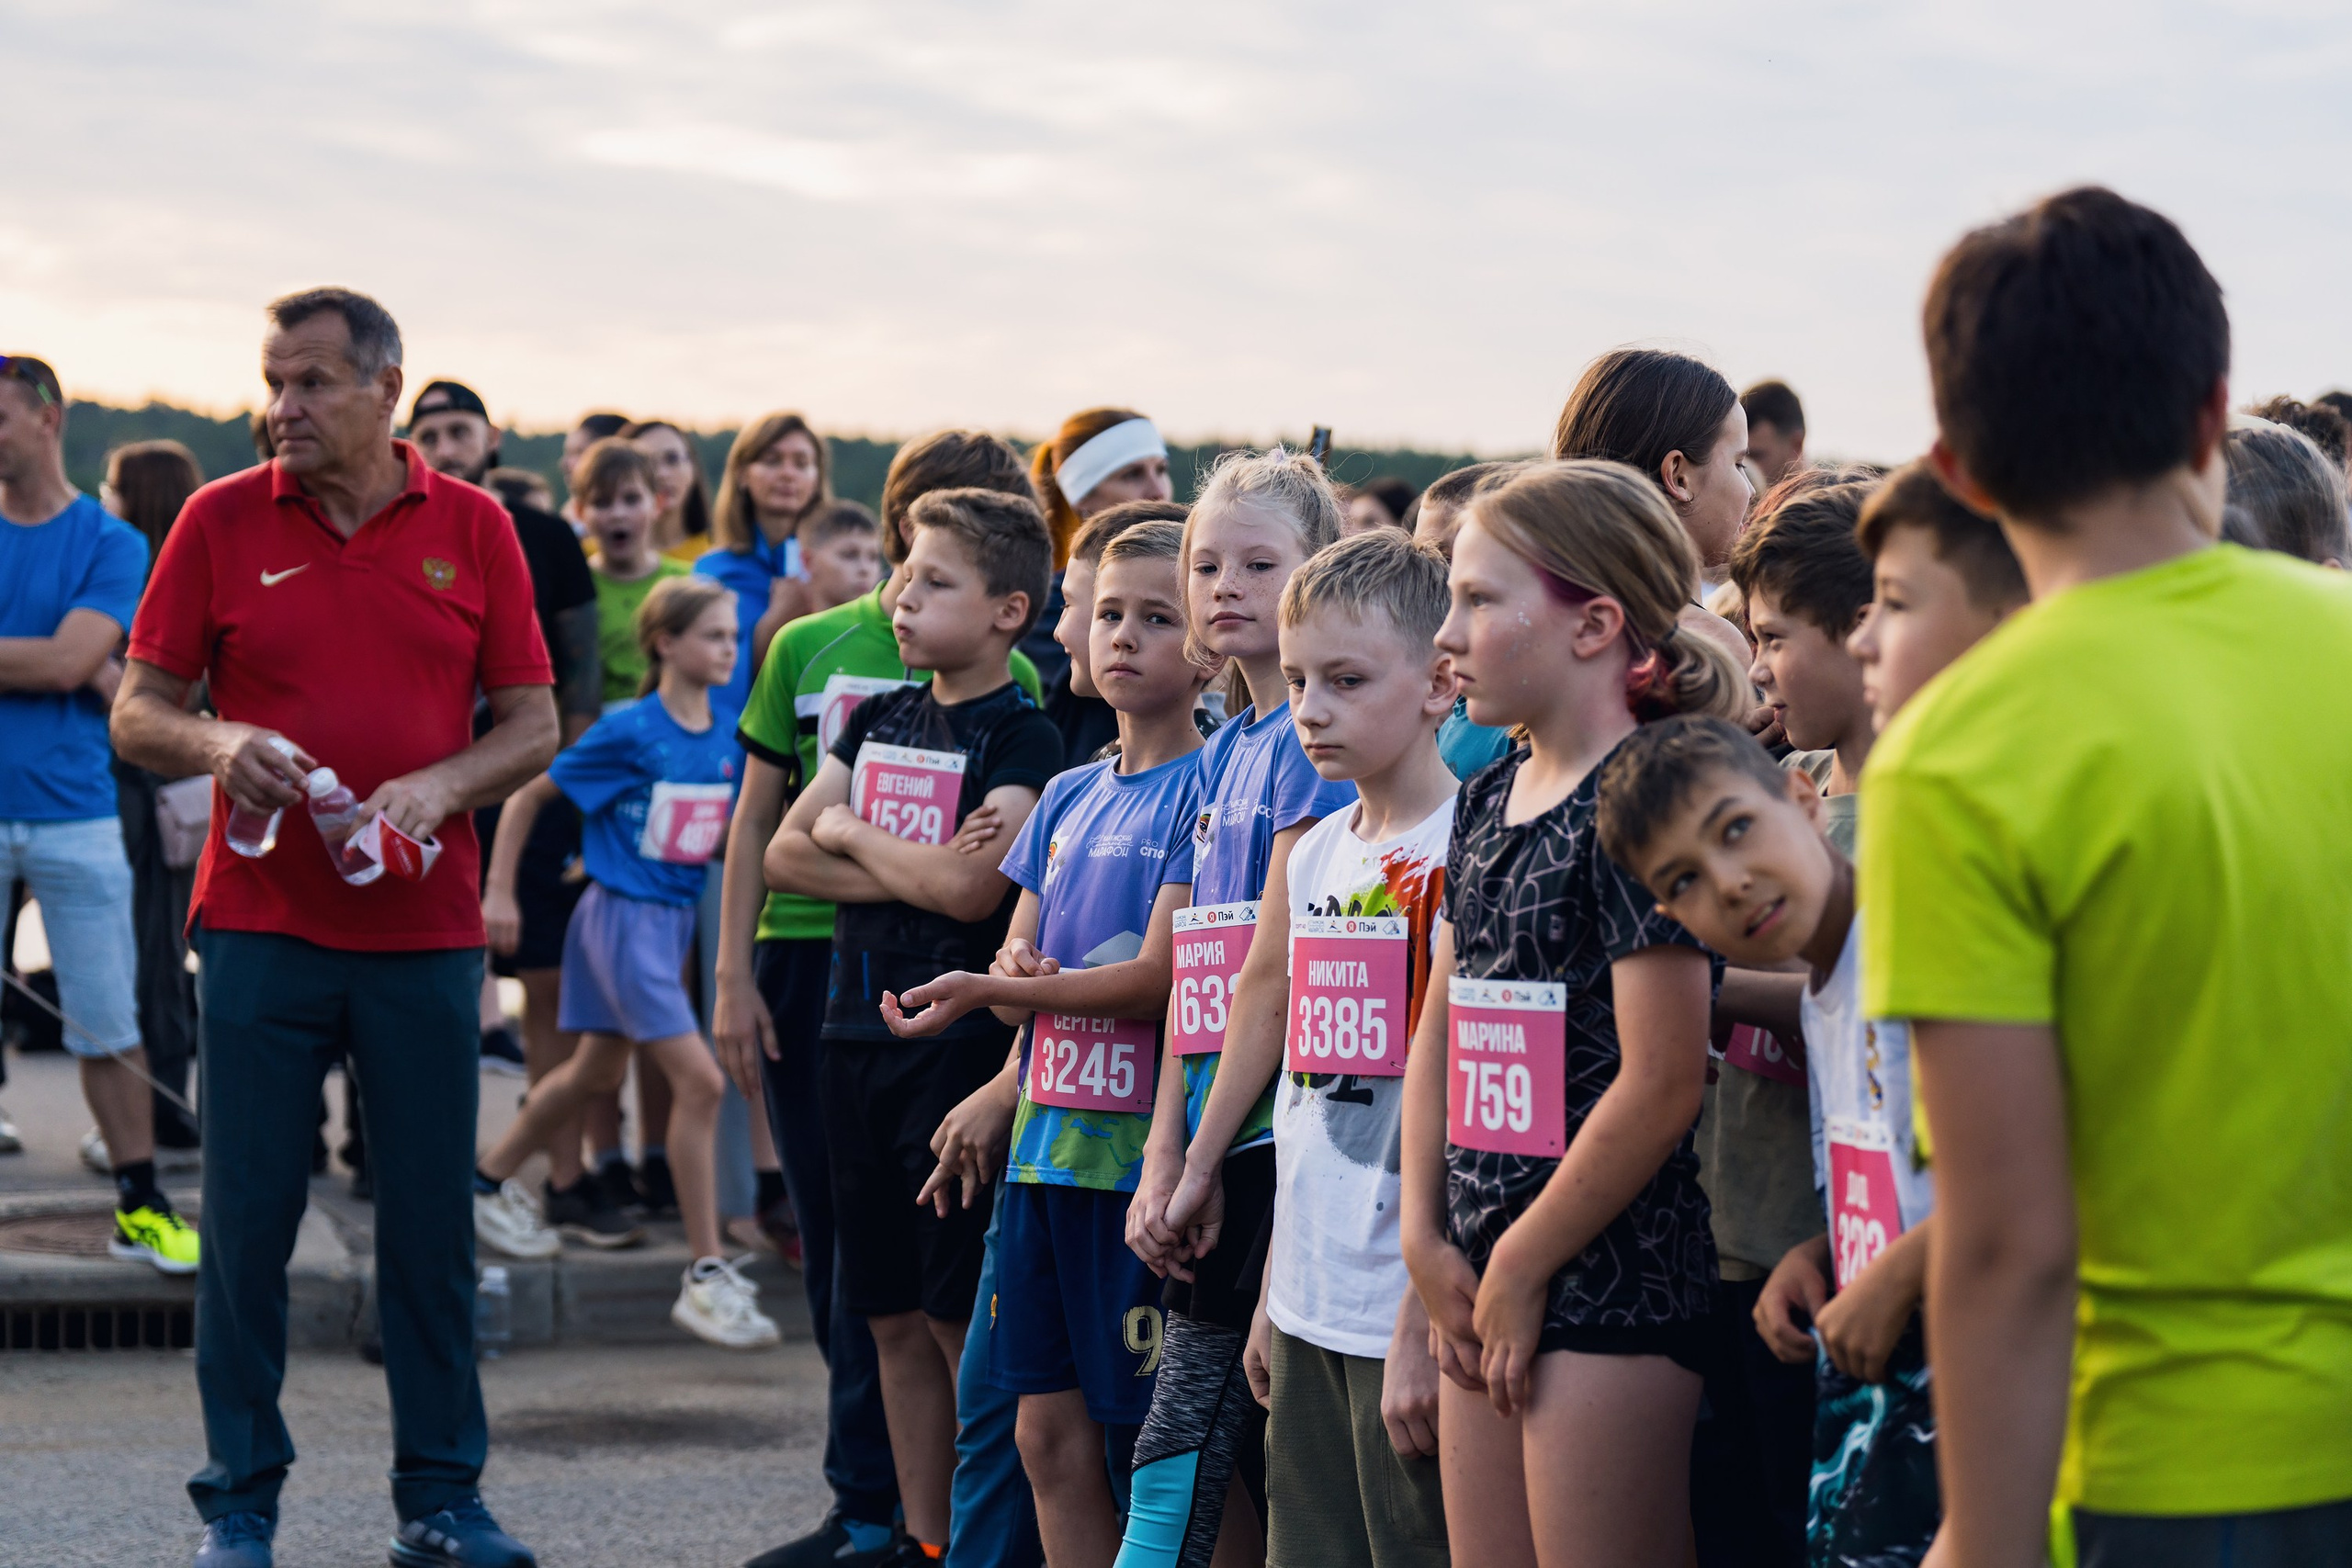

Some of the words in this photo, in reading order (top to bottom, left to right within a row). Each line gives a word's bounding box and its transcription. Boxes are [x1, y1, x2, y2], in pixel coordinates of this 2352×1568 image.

[876, 772, 934, 799] ЕВГЕНИЙ
[870, 798, 944, 846] 1529
[1140, 846, 1168, 860] СПО
[1217, 910, 1234, 921] Пэй
[1359, 922, 1376, 932] Пэй
[1177, 941, 1226, 969] МАРИЯ
[1308, 960, 1369, 987] НИКИТА
[1298, 995, 1387, 1060] 3385
[1457, 1020, 1526, 1054] МАРИНА
[1041, 1036, 1135, 1099] 3245
[1458, 1059, 1532, 1133] 759
[1123, 1305, 1163, 1377] 9
